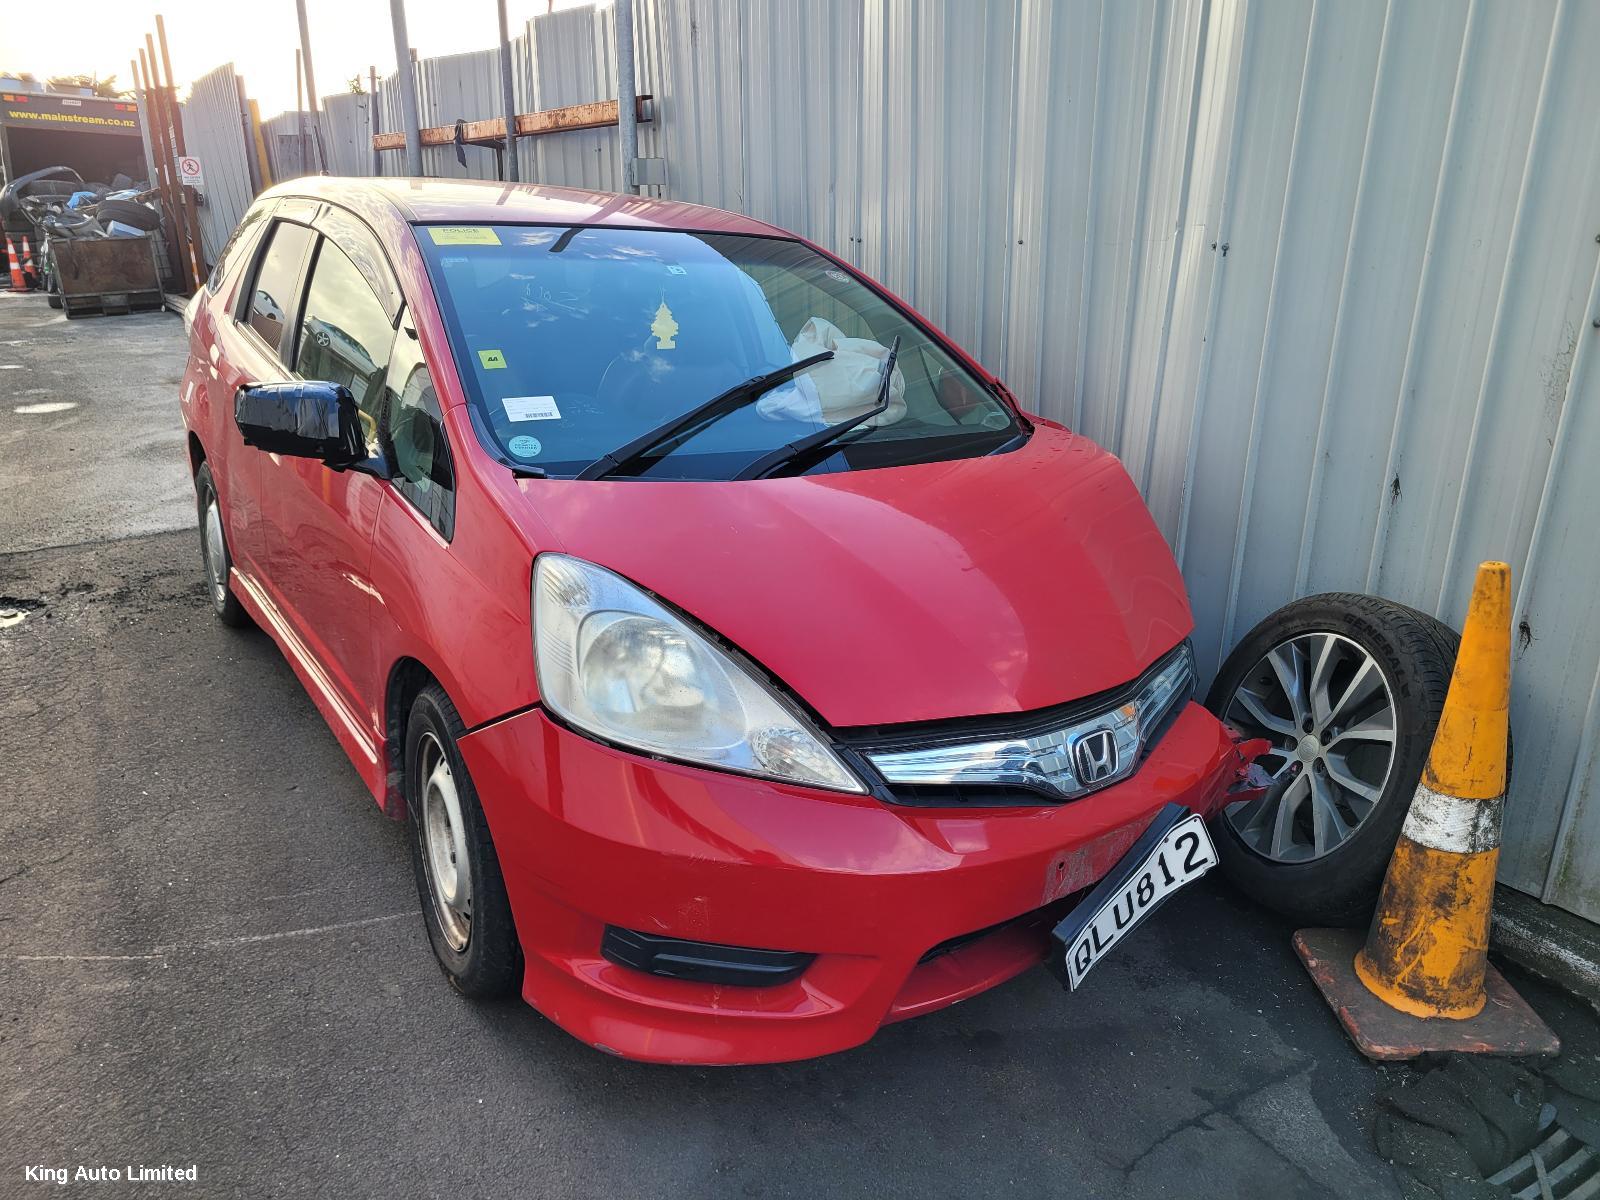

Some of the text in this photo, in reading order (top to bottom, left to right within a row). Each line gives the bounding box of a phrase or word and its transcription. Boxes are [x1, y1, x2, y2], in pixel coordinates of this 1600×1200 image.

[9, 110, 136, 127] www.mainstream.co.nz
[1344, 612, 1406, 685] GENERAL
[1074, 831, 1208, 976] QLU812
